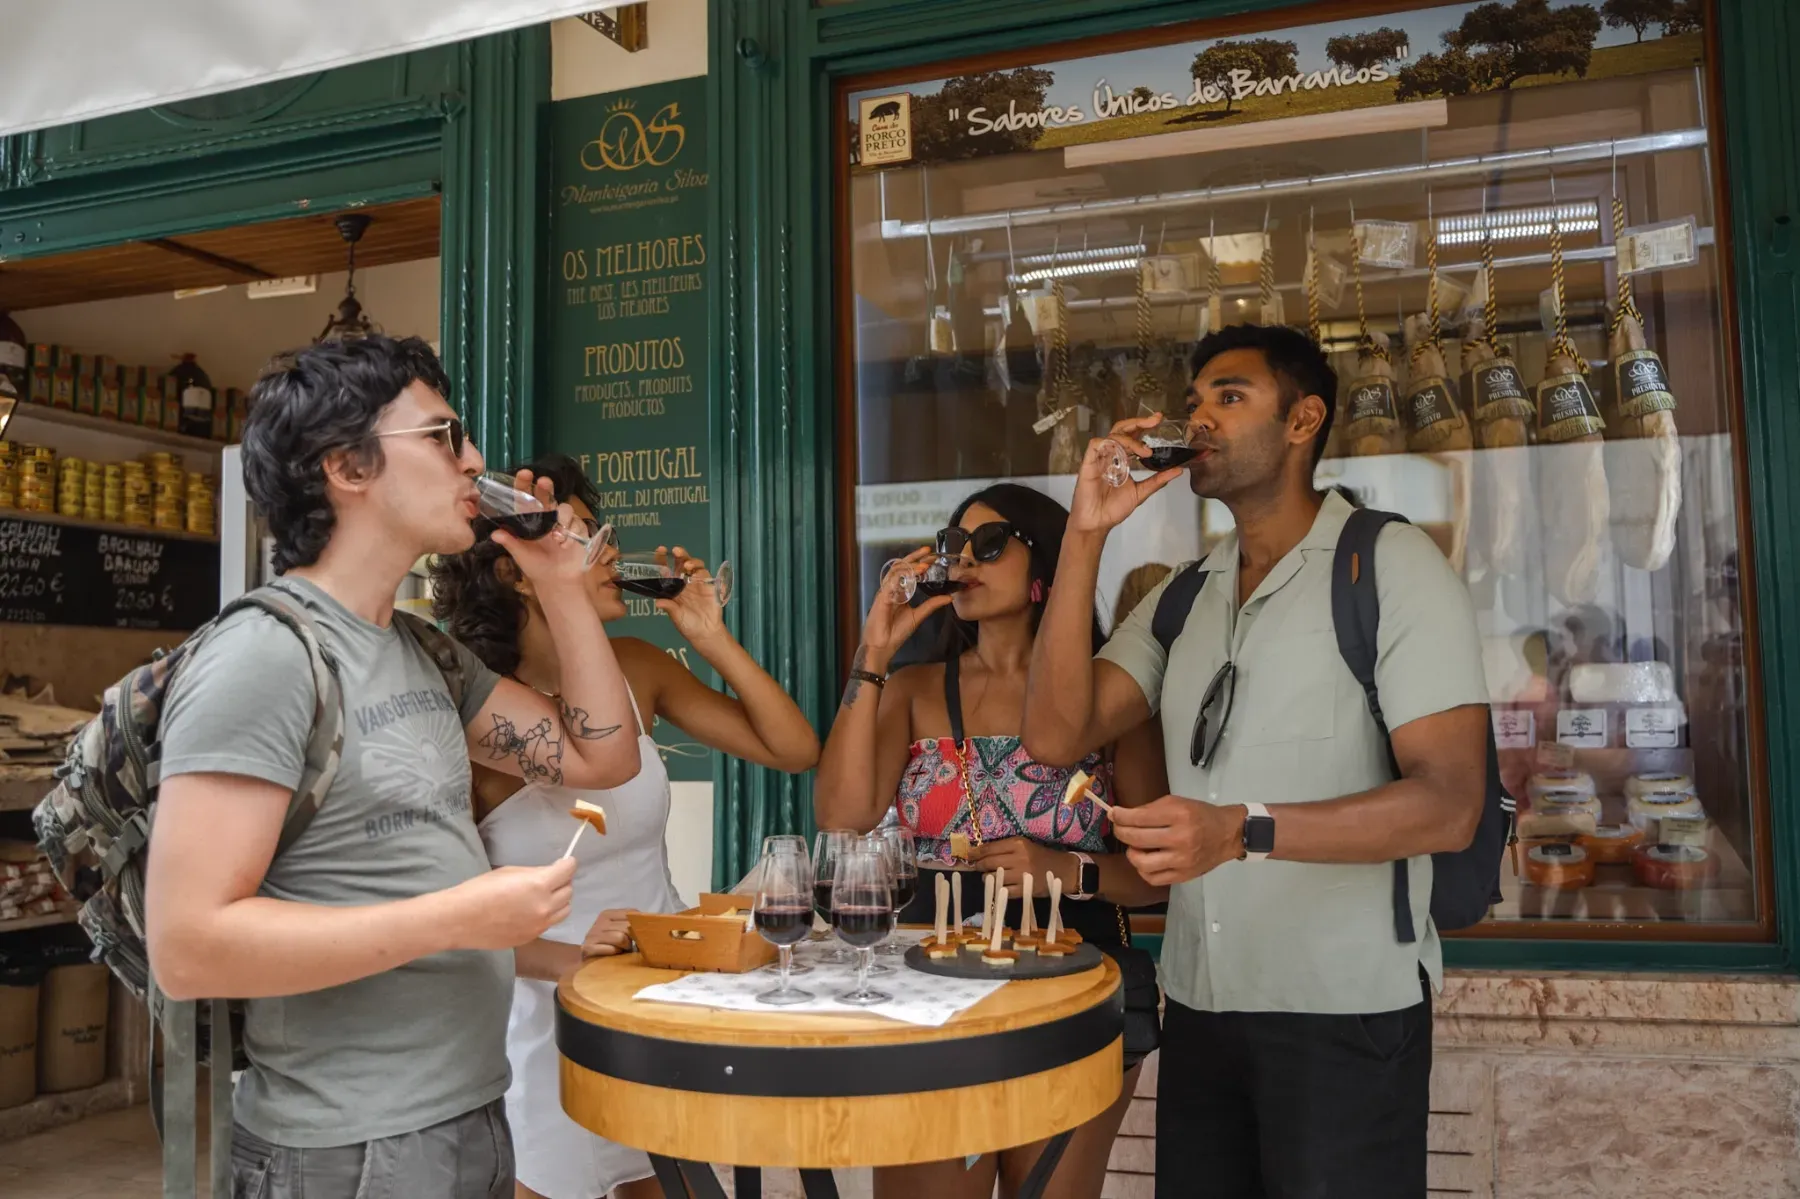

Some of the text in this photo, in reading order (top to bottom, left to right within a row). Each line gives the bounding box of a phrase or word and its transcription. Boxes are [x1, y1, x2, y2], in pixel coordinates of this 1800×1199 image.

[1092, 78, 1179, 118] Únicos
[1186, 78, 1222, 106] de
[865, 129, 906, 142] PORCO
[865, 138, 906, 152] PRETO
[563, 234, 706, 281] OS MELHORES
[620, 279, 639, 298] LES
[597, 296, 670, 320] LOS MEJORES
[584, 336, 685, 377] PRODUTOS
[638, 375, 693, 402] PRODUITS
[601, 397, 665, 420] PRODUCTOS
[597, 446, 702, 484] PORTUGAL
[635, 488, 651, 507] DU
[653, 484, 710, 506] PORTUGAL
[619, 511, 662, 528] PORTUGAL
